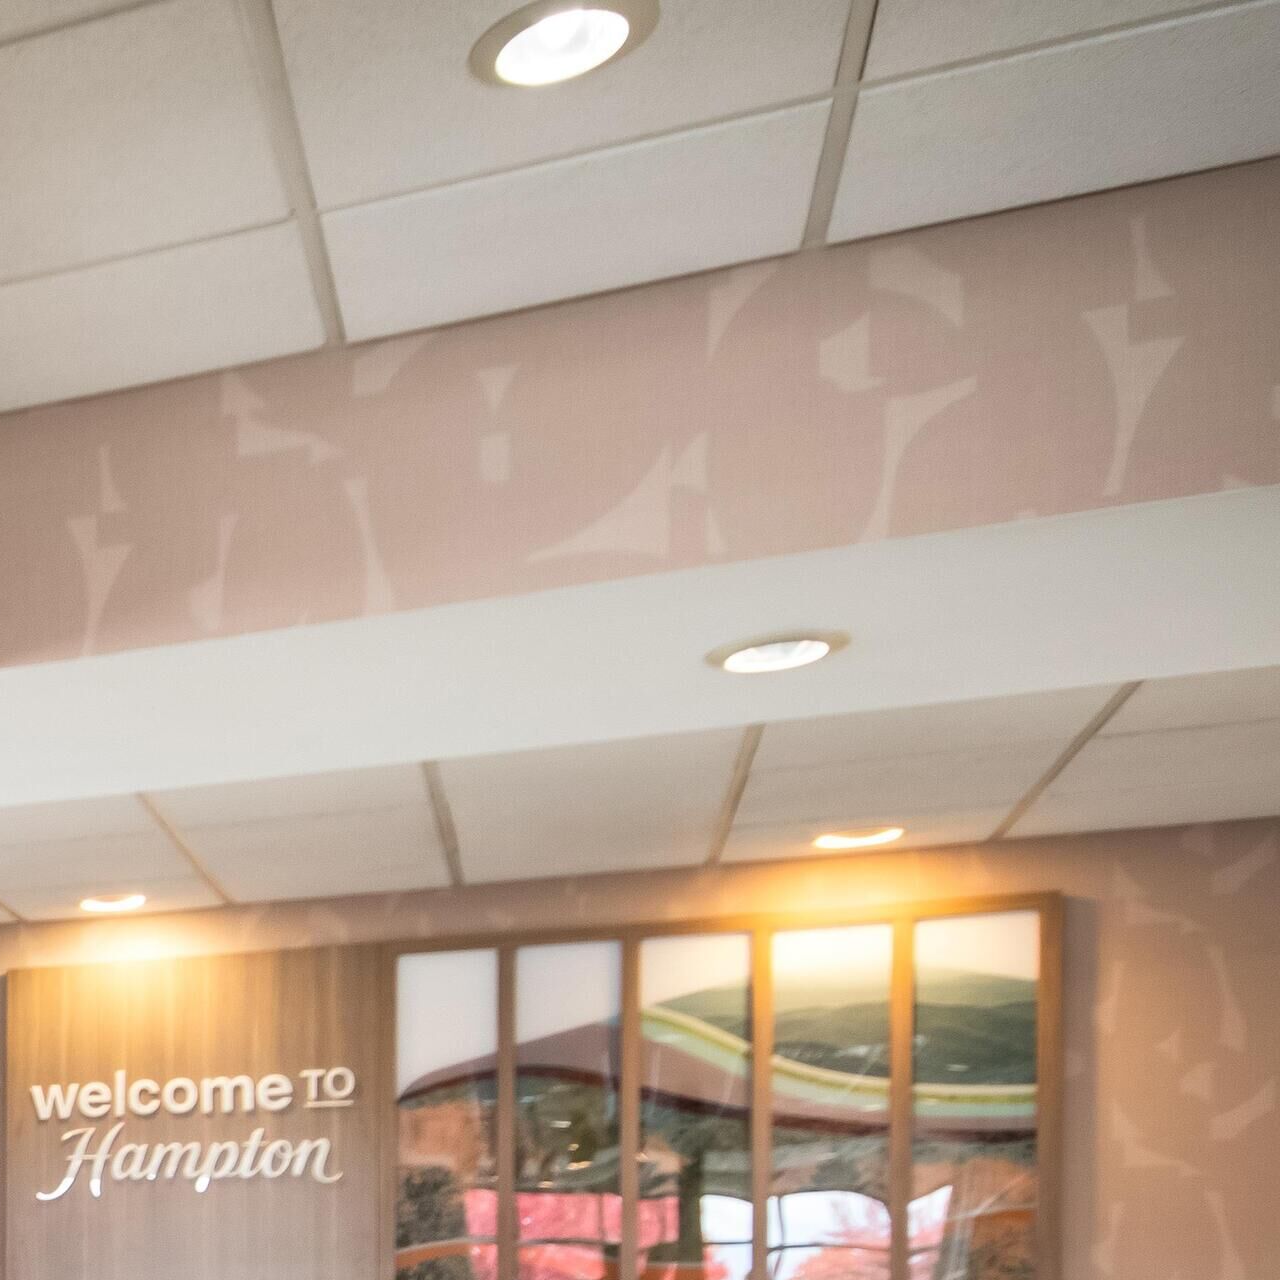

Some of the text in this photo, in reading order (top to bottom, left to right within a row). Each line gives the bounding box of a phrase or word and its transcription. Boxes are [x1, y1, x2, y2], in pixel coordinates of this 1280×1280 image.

[30, 1067, 357, 1121] welcome TO
[36, 1121, 344, 1200] Hampton
